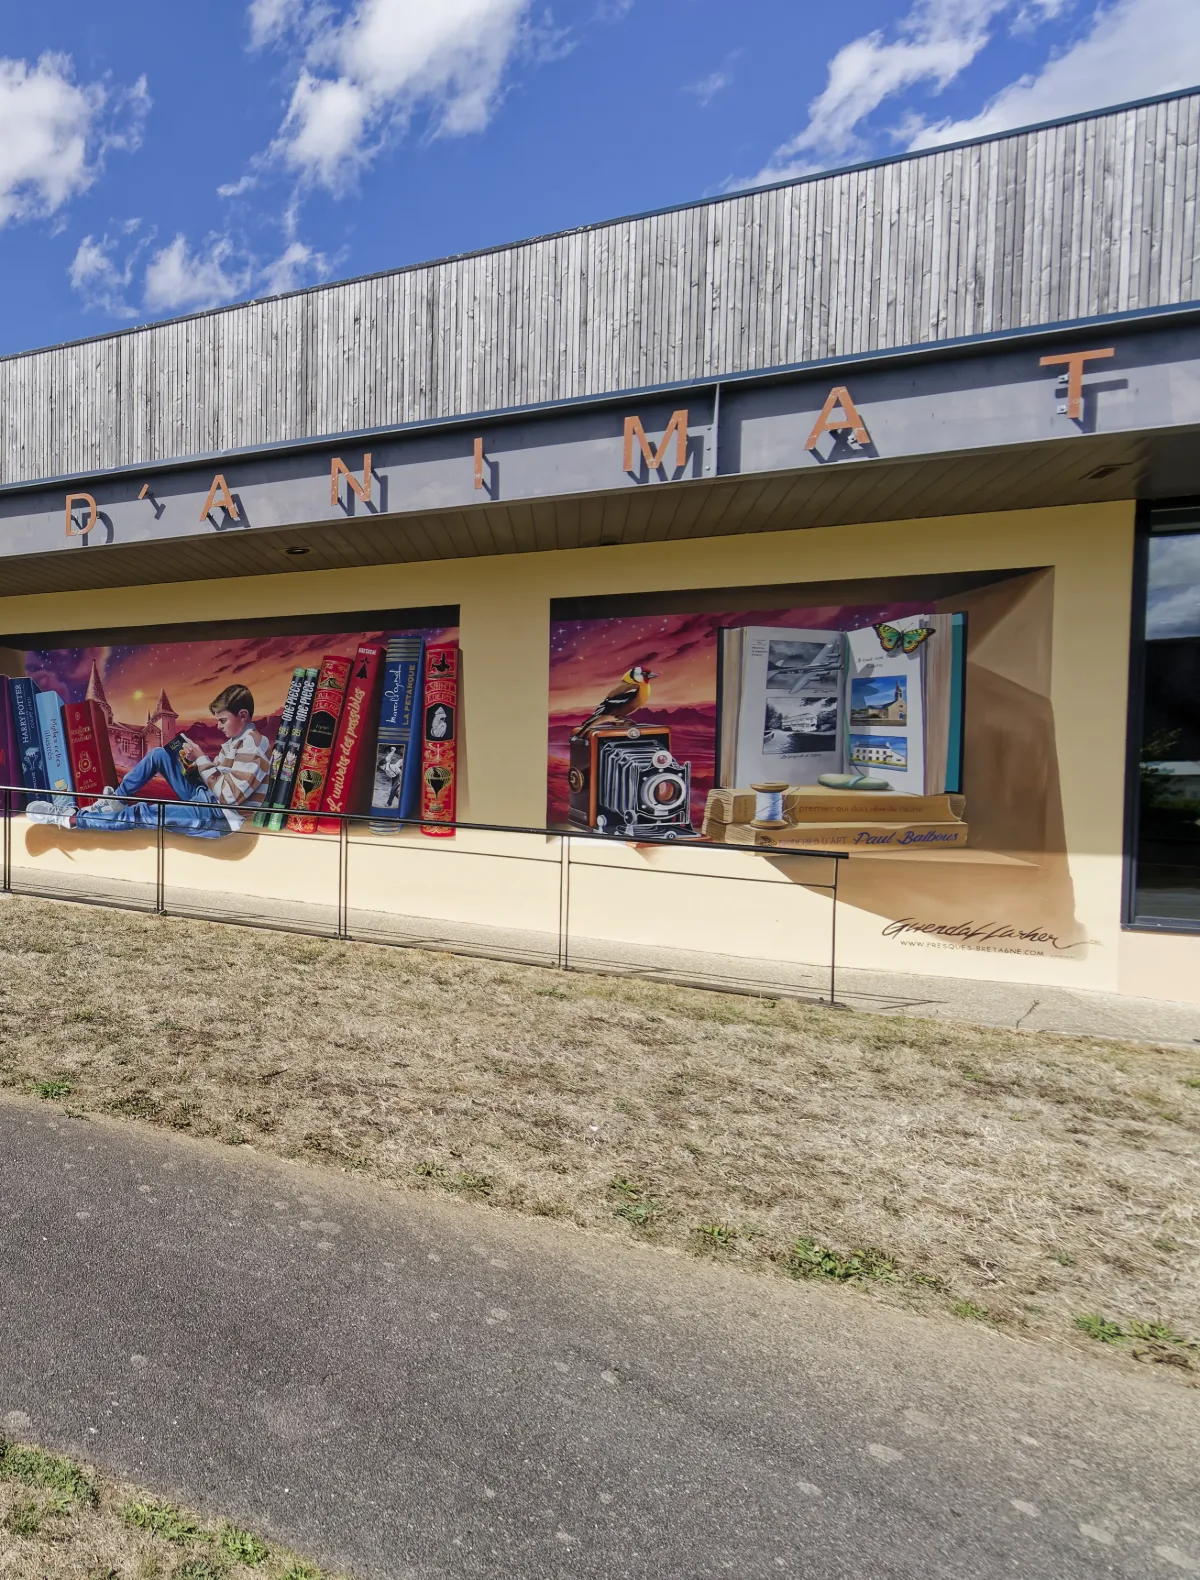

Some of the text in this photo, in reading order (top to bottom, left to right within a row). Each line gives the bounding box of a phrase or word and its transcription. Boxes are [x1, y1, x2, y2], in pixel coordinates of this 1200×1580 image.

[15, 684, 29, 744] HARRY POTTER
[402, 664, 416, 726] LA PETANQUE
[326, 686, 366, 812] L'univers des possibles
[799, 804, 835, 814] premier
[836, 806, 849, 814] qui
[853, 831, 897, 845] Paul
[899, 940, 1045, 957] WWW.FRESQUES-BRETAGNE.COM
